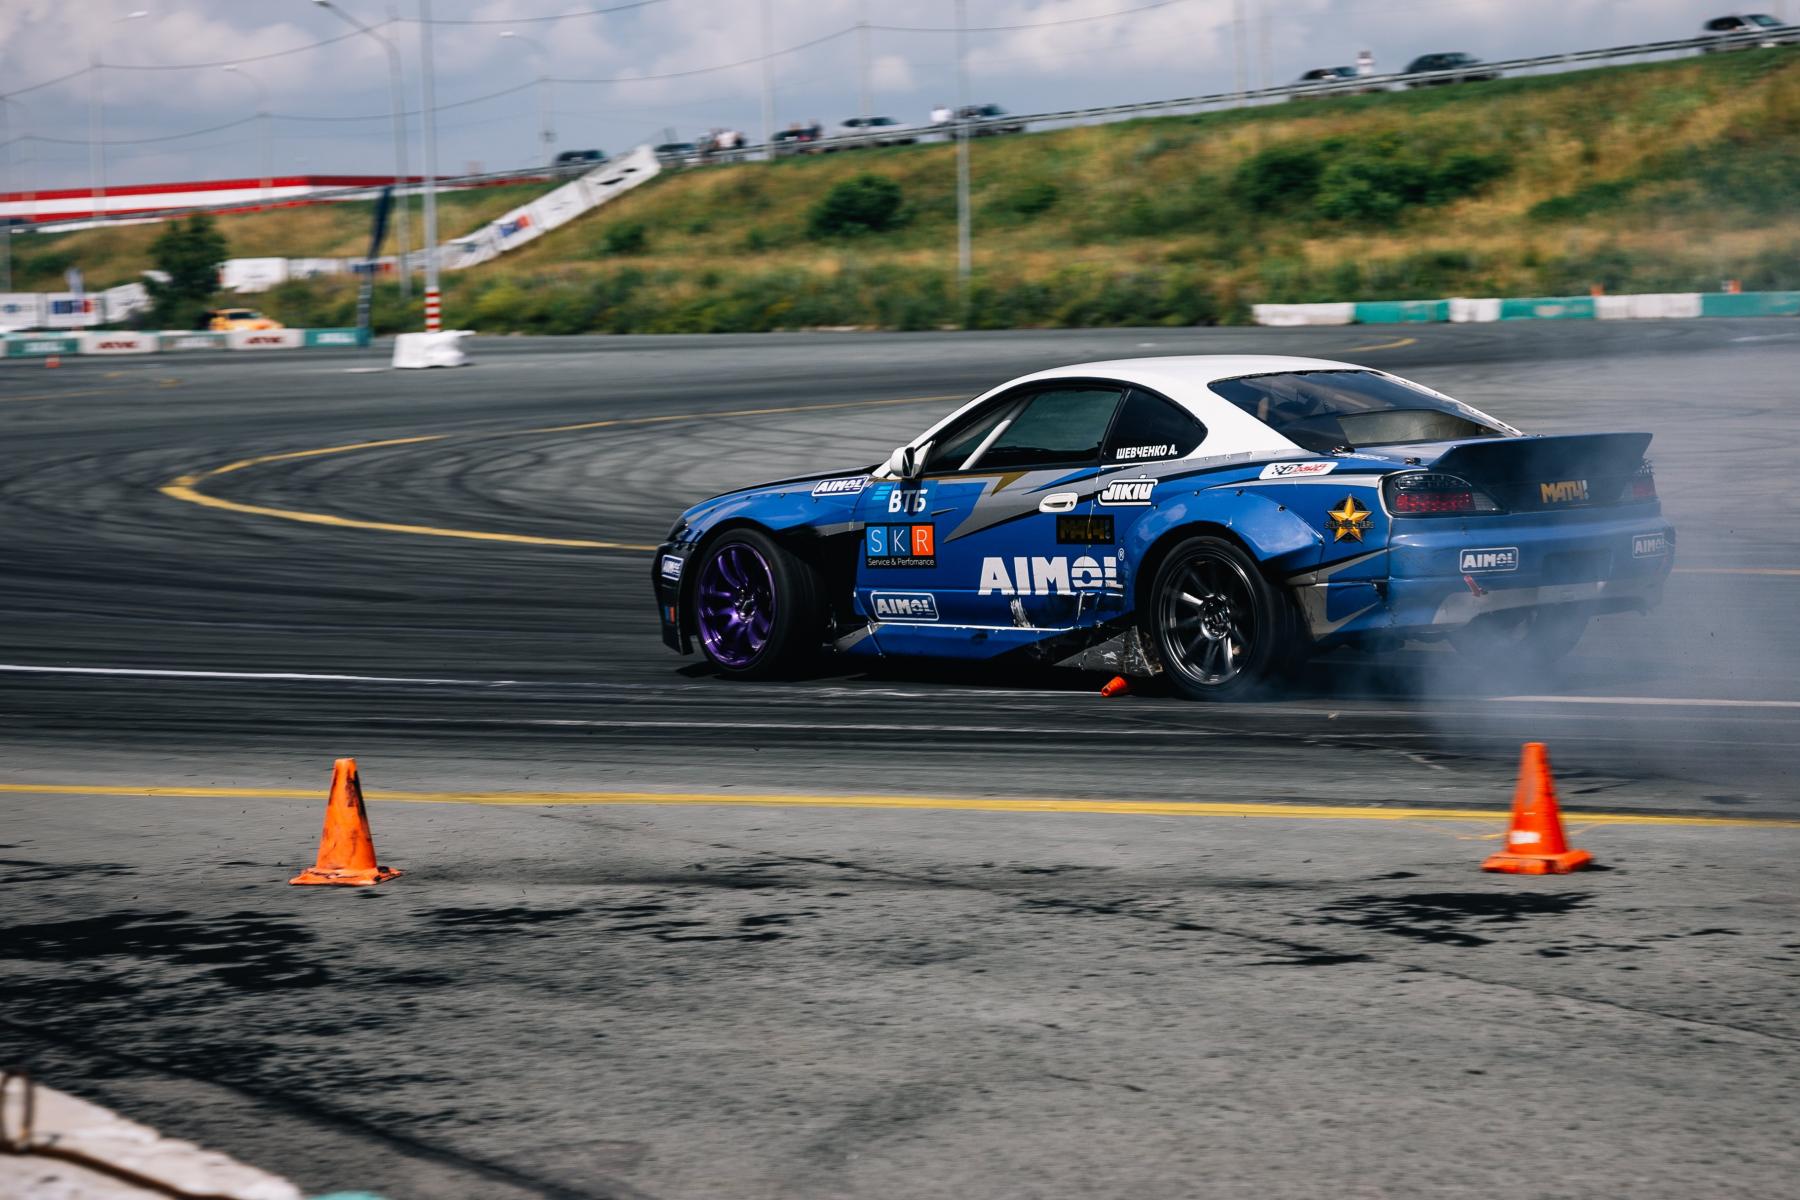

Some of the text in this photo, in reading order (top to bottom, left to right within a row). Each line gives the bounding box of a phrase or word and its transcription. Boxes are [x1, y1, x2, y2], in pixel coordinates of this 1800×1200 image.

[1116, 444, 1178, 460] ШЕВЧЕНКО А.
[1101, 483, 1154, 500] JIKIU
[888, 489, 929, 513] ВТБ
[871, 529, 929, 553] SKR
[868, 558, 890, 567] Service
[891, 558, 897, 567] &
[1463, 551, 1516, 569] AIMOL
[877, 598, 934, 615] AIMOL
